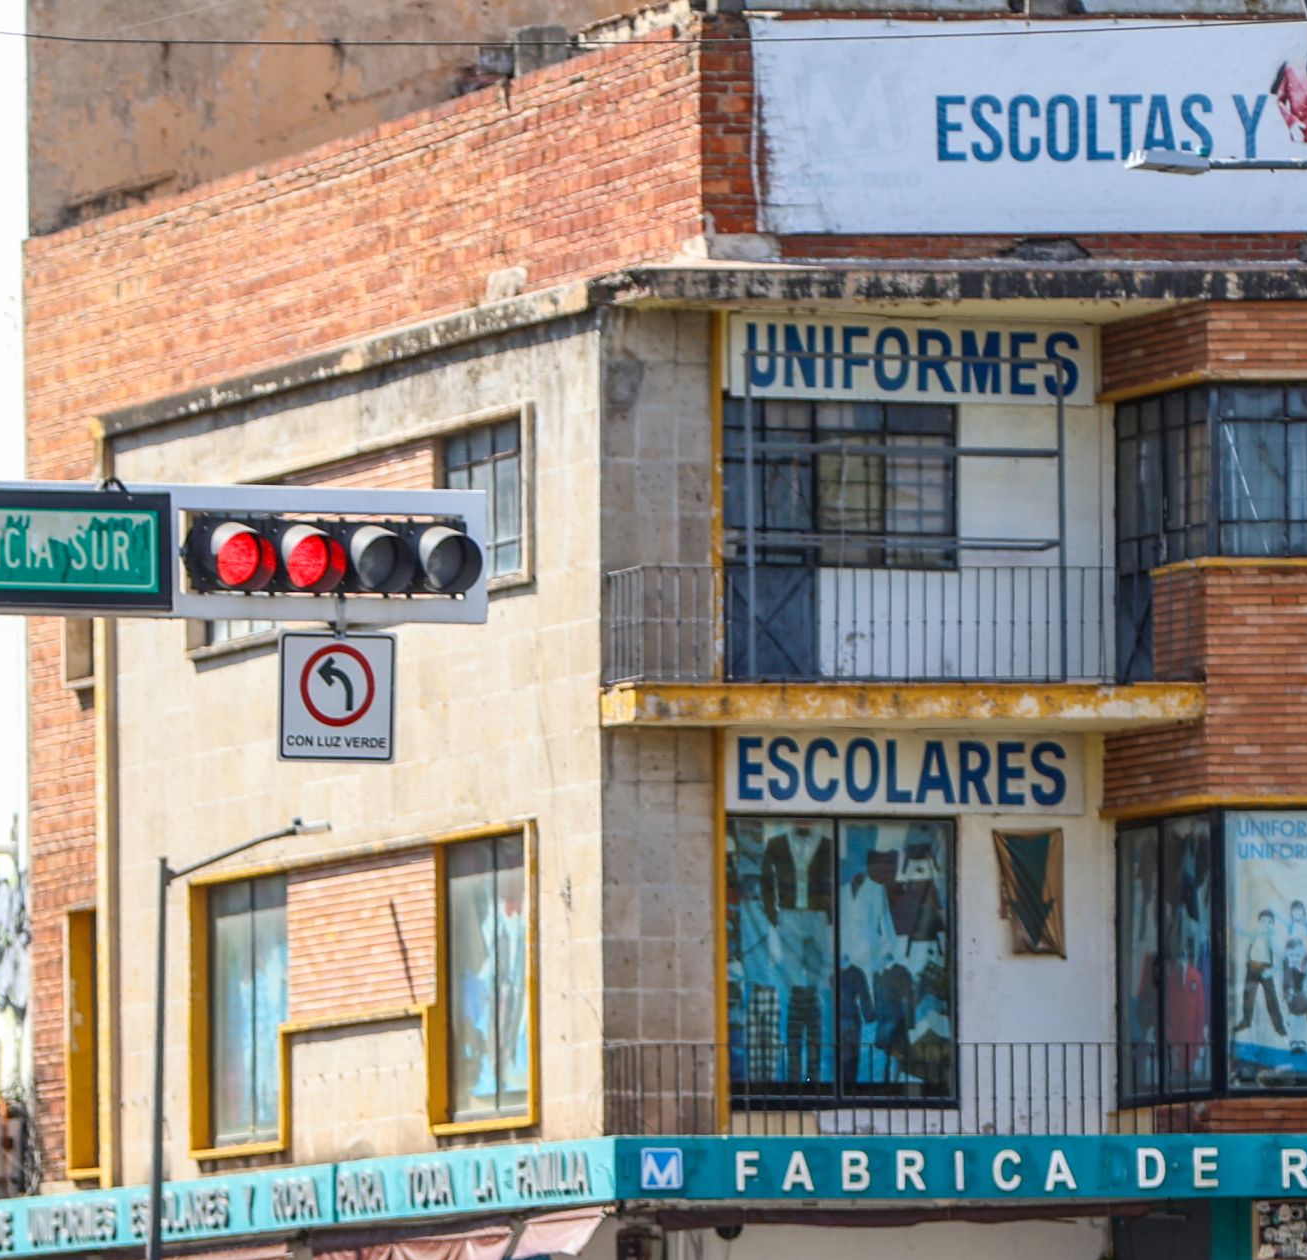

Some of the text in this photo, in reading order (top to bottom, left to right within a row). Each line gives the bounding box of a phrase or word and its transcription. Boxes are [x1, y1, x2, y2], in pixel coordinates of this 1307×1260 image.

[935, 93, 1268, 161] ESCOLTAS Y
[746, 322, 1080, 398] UNIFORMES
[70, 529, 131, 571] SUR
[286, 734, 387, 748] CON LUZ VERDE
[737, 735, 1067, 806] ESCOLARES
[641, 1152, 679, 1188] M
[735, 1150, 1077, 1192] FABRICA
[1137, 1147, 1219, 1189] DE
[28, 1203, 117, 1247] UNIFORMES
[131, 1186, 231, 1237] ESOLARES
[272, 1176, 320, 1223] ROPA
[335, 1169, 387, 1216] PARA
[405, 1162, 455, 1210] TODA
[473, 1156, 500, 1203] LA
[517, 1150, 591, 1198] FAMILIA
